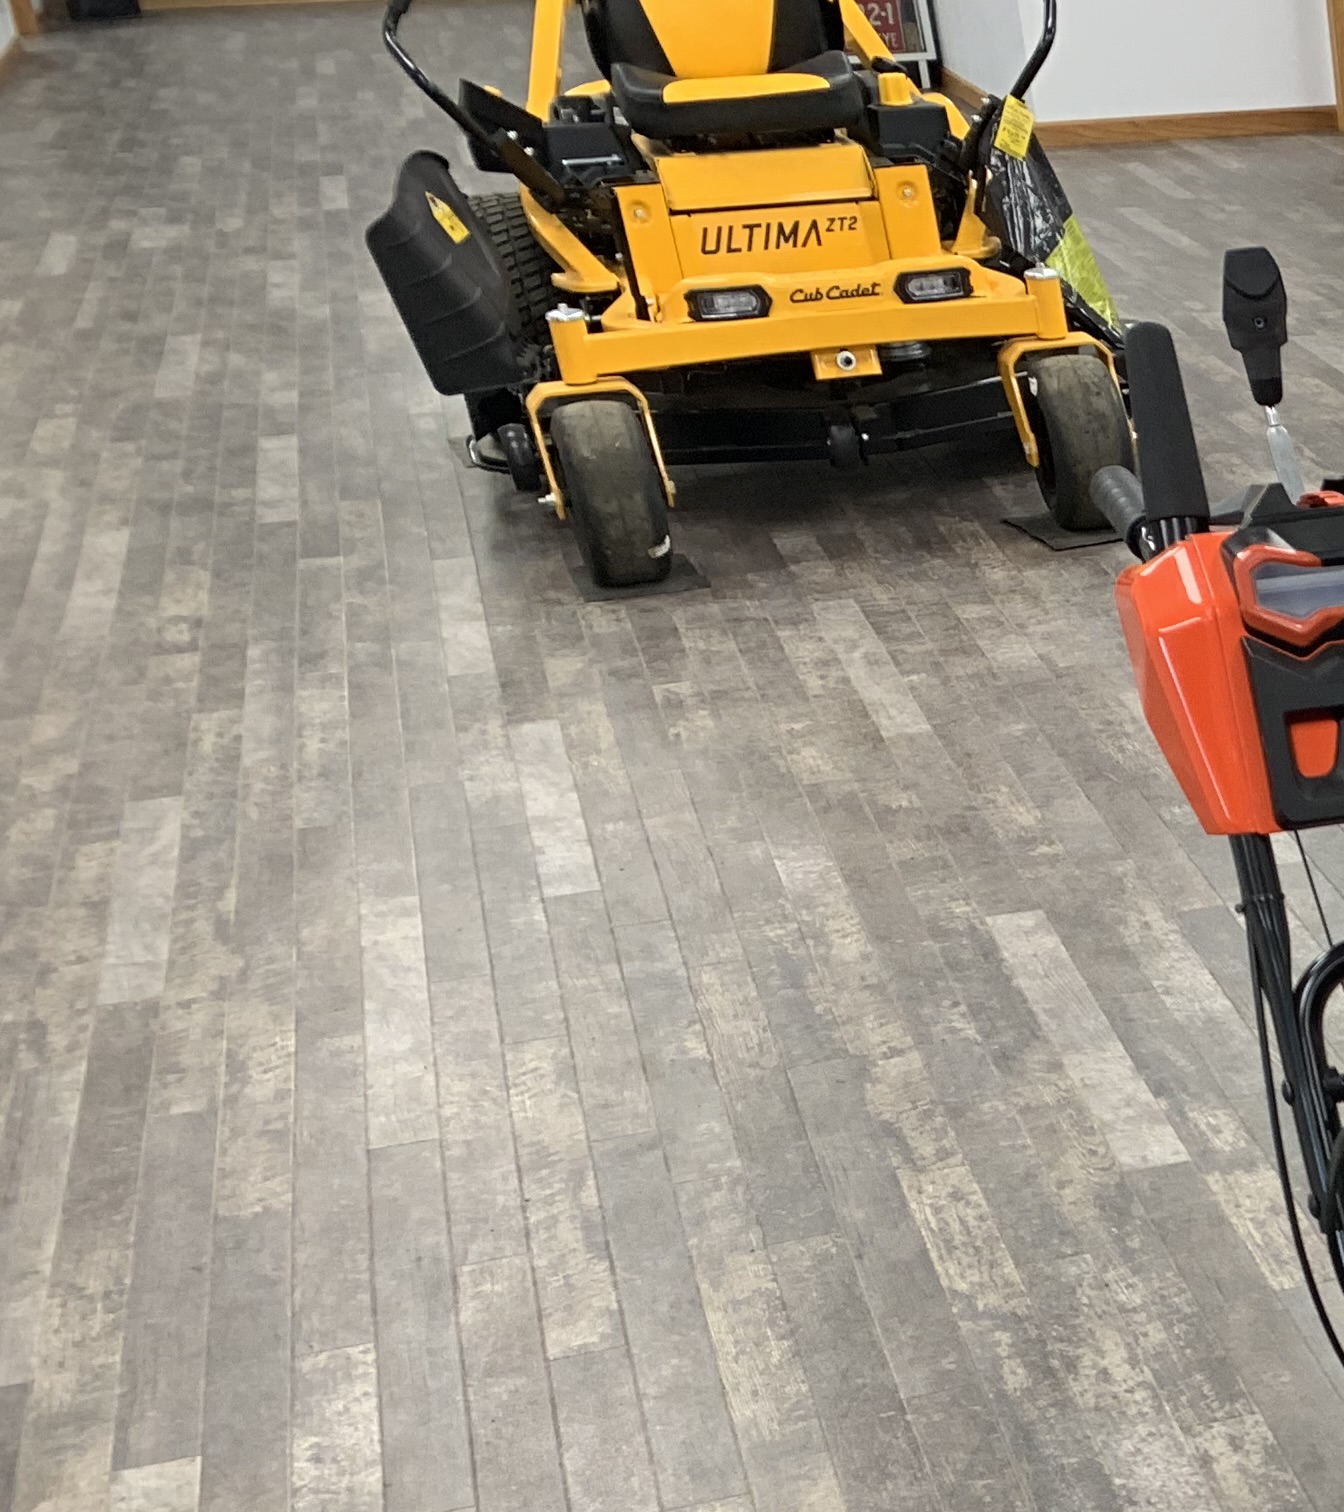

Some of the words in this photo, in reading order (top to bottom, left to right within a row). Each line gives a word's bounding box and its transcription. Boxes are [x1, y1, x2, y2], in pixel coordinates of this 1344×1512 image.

[700, 218, 823, 256] ULTIMA
[825, 215, 858, 232] ZT2
[790, 286, 823, 303] Cub
[826, 282, 881, 300] Cadet
